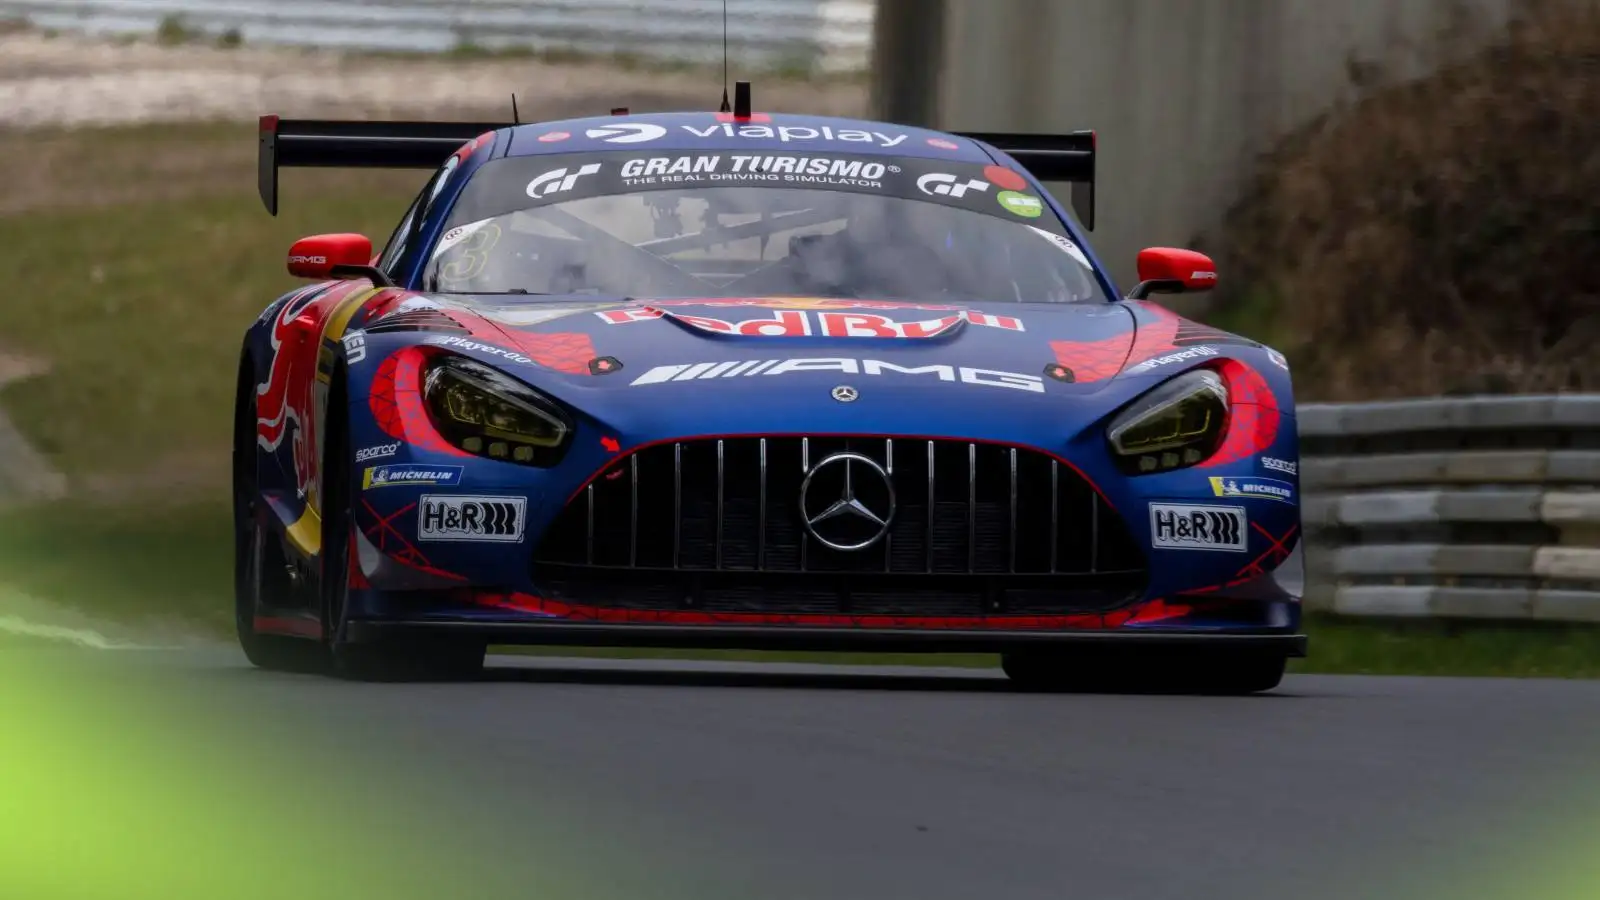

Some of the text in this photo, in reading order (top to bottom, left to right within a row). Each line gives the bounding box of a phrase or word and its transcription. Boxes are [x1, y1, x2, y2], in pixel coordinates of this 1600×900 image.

[681, 122, 909, 147] viaplay
[620, 156, 720, 178] GRAN
[623, 173, 882, 189] THE REAL DRIVING SIMULATOR
[442, 223, 502, 282] 3
[763, 357, 1046, 393] AMG
[389, 470, 453, 481] MICHELIN
[1242, 483, 1292, 498] MICHELIN
[423, 501, 483, 534] H&R
[1155, 509, 1209, 540] H&R
